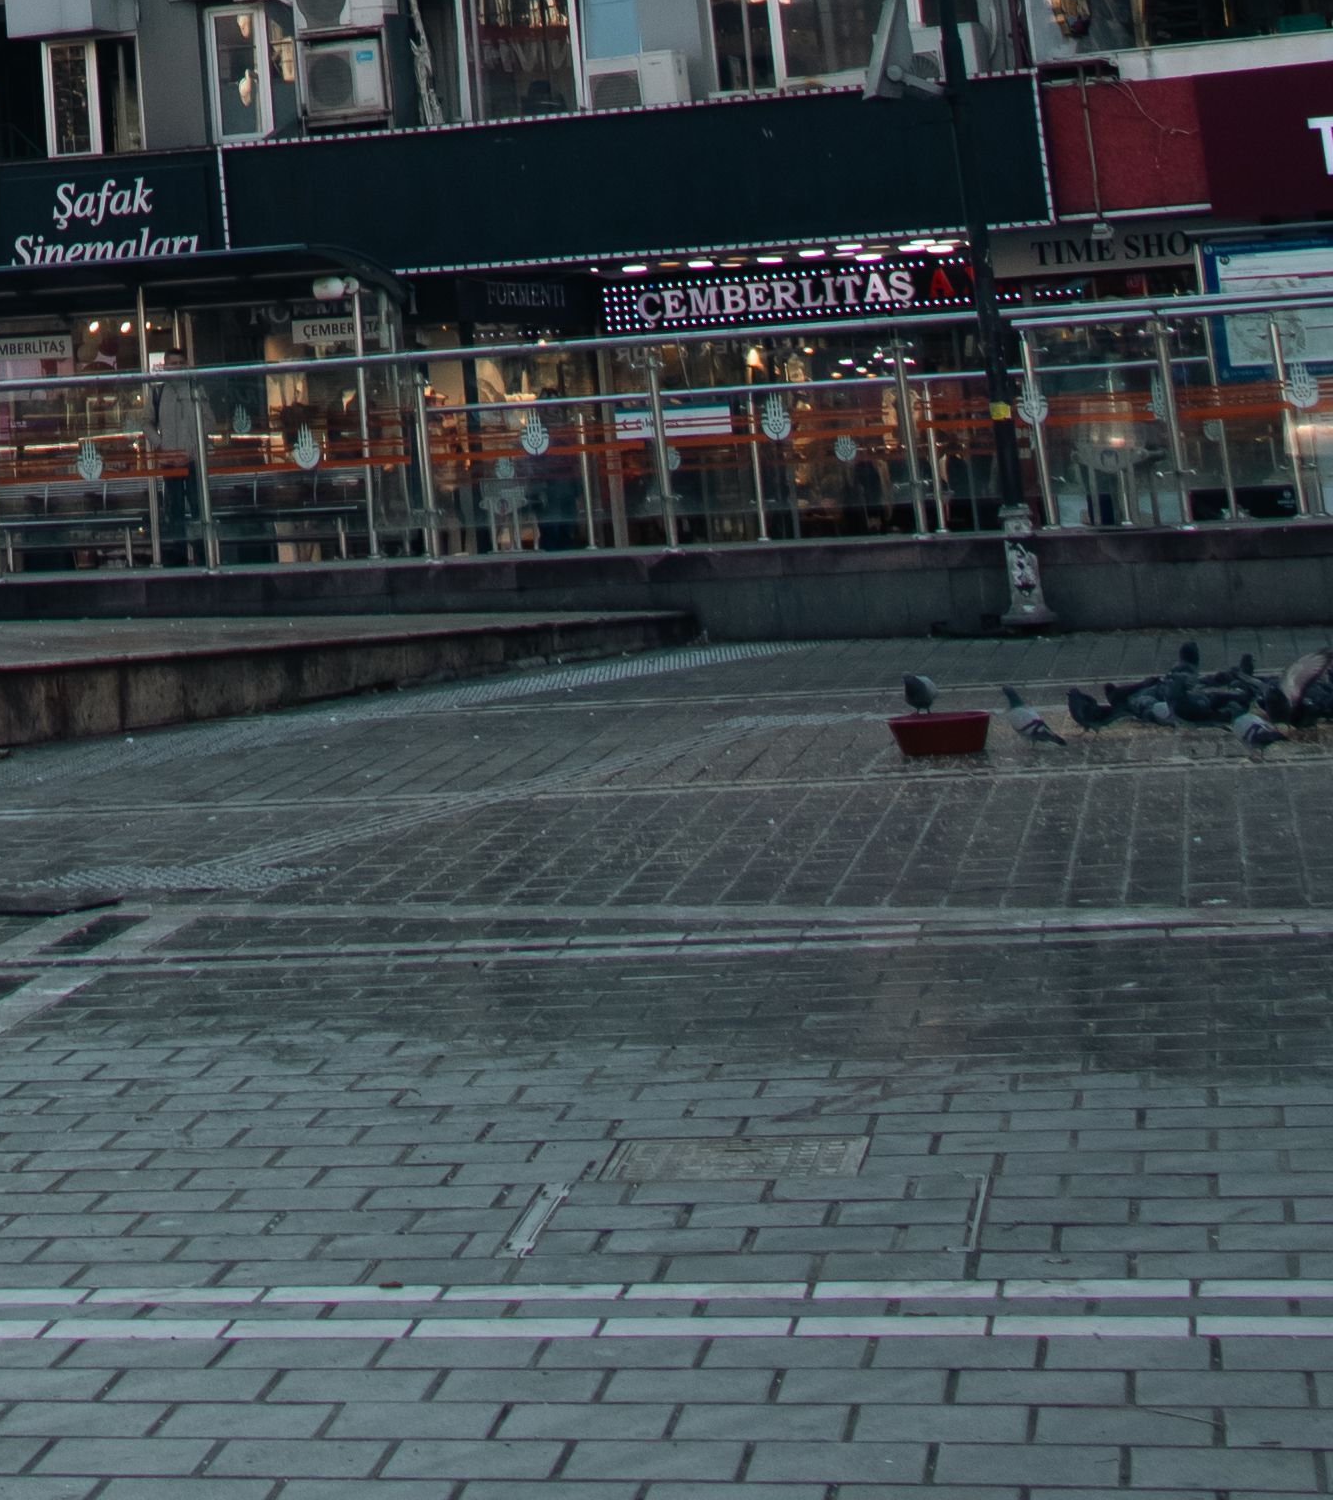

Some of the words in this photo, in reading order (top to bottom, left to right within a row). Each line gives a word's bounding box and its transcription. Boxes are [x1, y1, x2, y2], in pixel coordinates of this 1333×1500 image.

[52, 176, 153, 230] Şafak
[1031, 238, 1116, 267] TIME
[1124, 230, 1193, 261] SHO
[637, 271, 917, 329] ÇEMBERLİTAŞ
